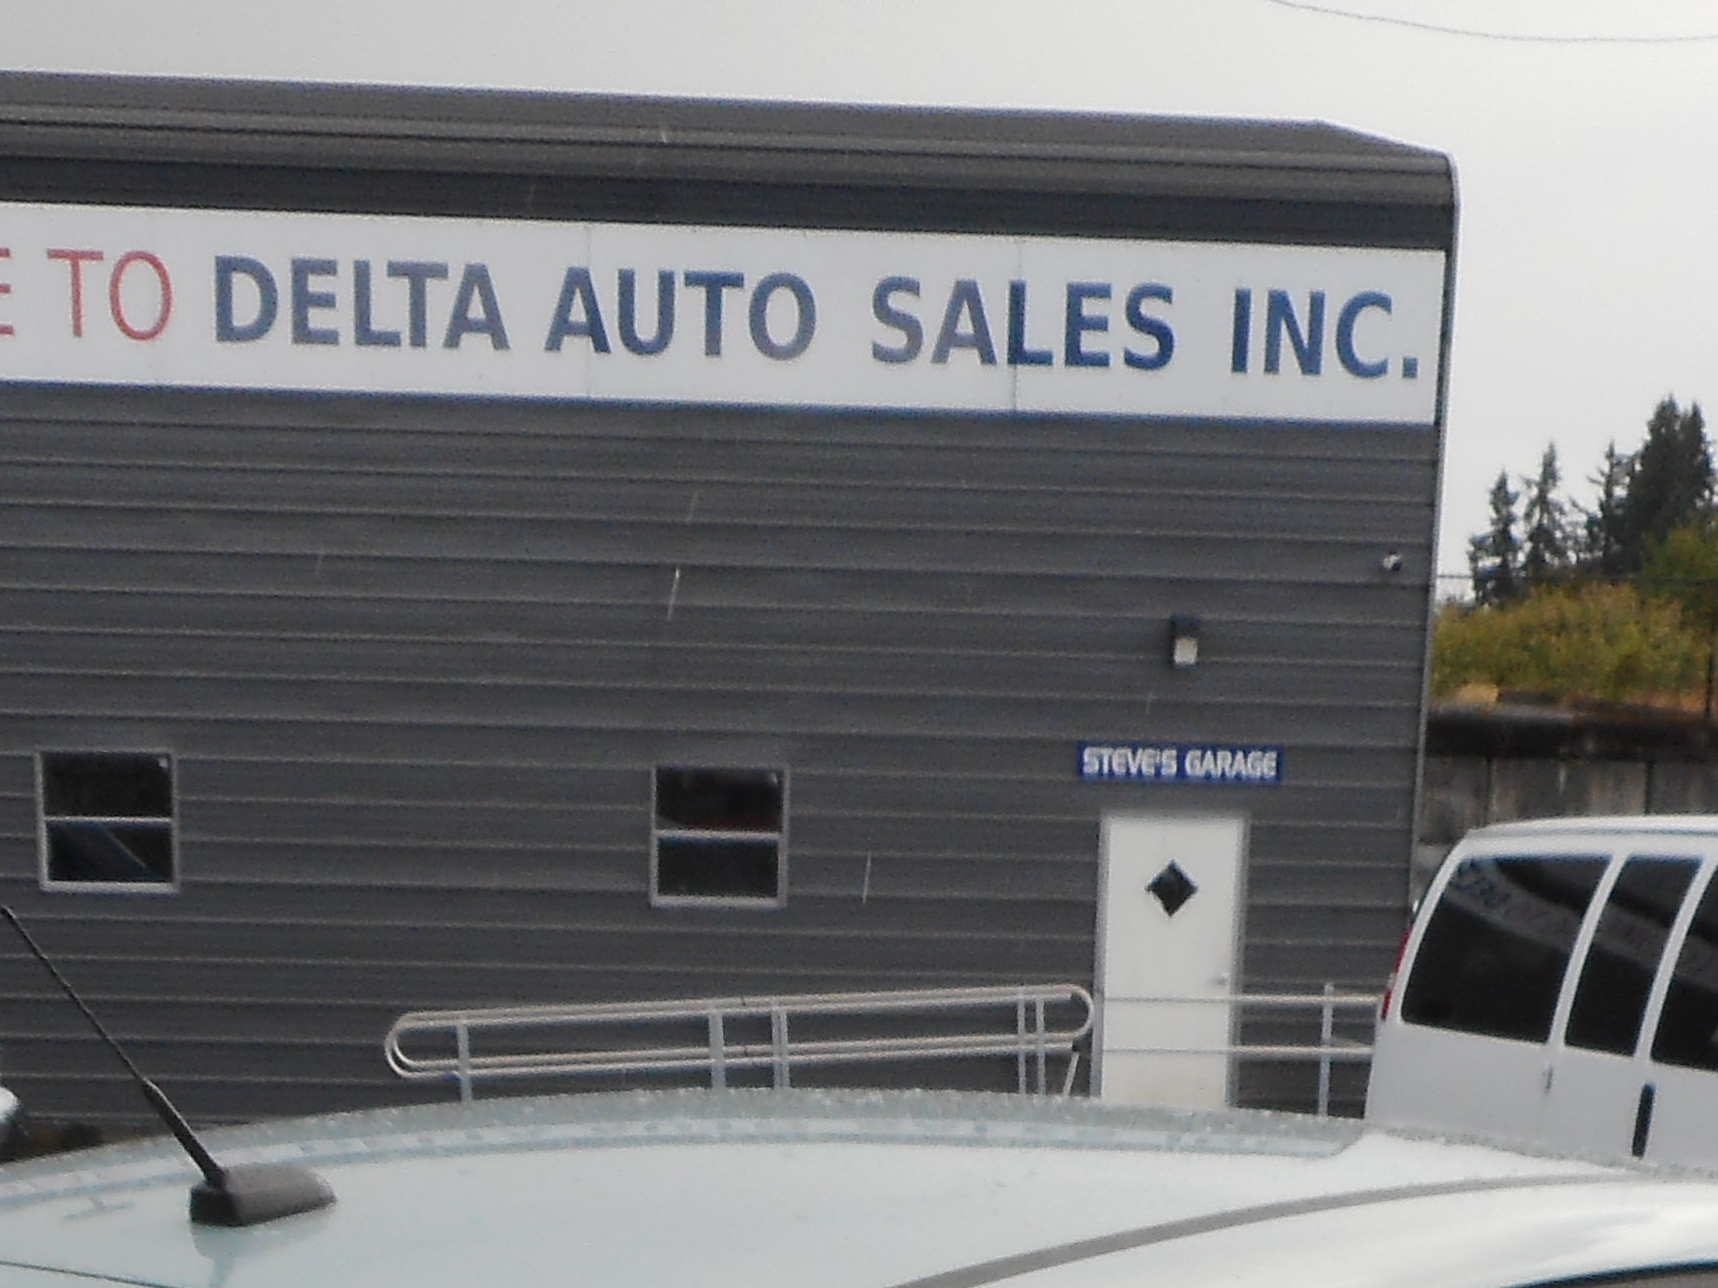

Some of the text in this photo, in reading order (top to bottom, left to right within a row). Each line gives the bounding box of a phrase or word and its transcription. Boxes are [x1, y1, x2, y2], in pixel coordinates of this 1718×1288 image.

[45, 247, 174, 341] TO
[214, 254, 511, 352] DELTA
[544, 266, 817, 361] AUTO
[870, 276, 1177, 372] SALES
[1230, 287, 1421, 380] INC.
[1084, 746, 1278, 779] STEVE'S GARAGE
